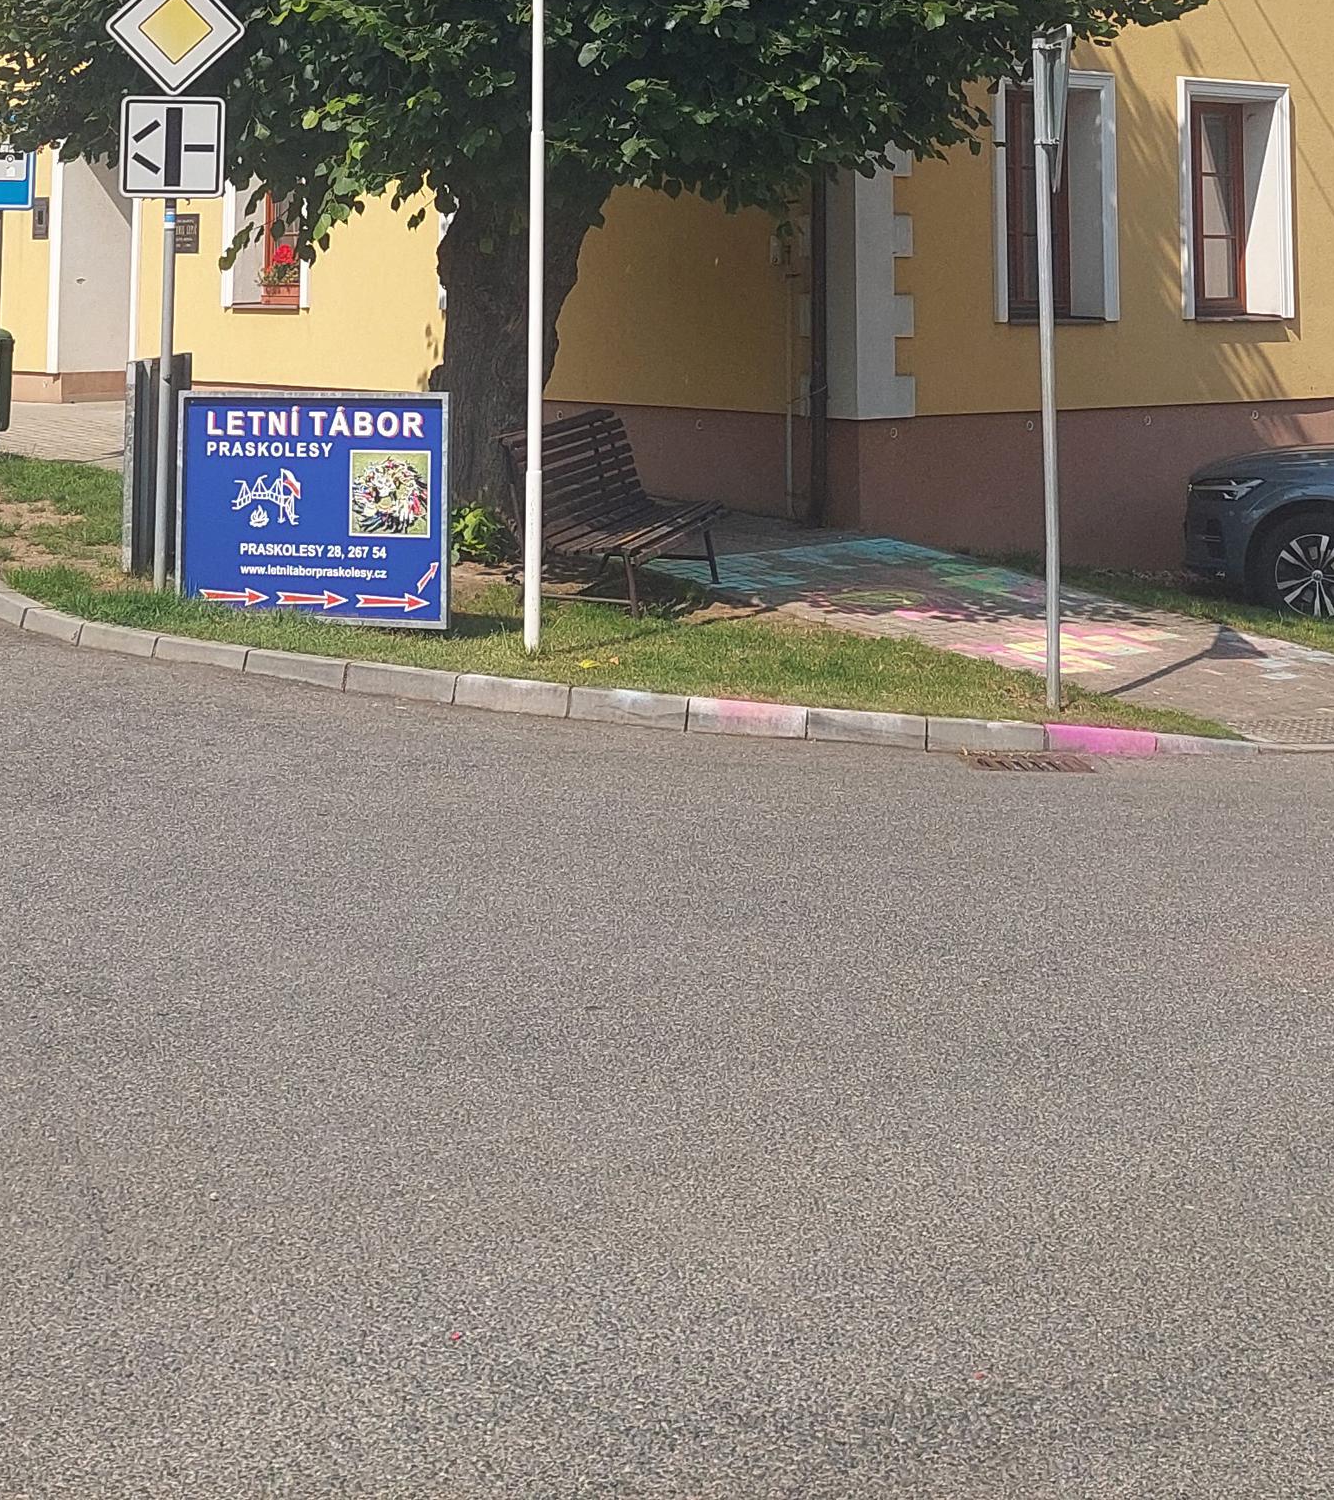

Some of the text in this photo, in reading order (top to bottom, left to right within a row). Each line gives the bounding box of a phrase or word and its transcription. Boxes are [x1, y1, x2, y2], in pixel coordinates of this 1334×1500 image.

[206, 405, 425, 439] LETNÍ TÁBOR
[206, 441, 333, 458] PRASKOLESY
[239, 542, 387, 560] PRASKOLESY 28, 267 54
[239, 563, 388, 581] www.letnitaborpraskolesy.cz
